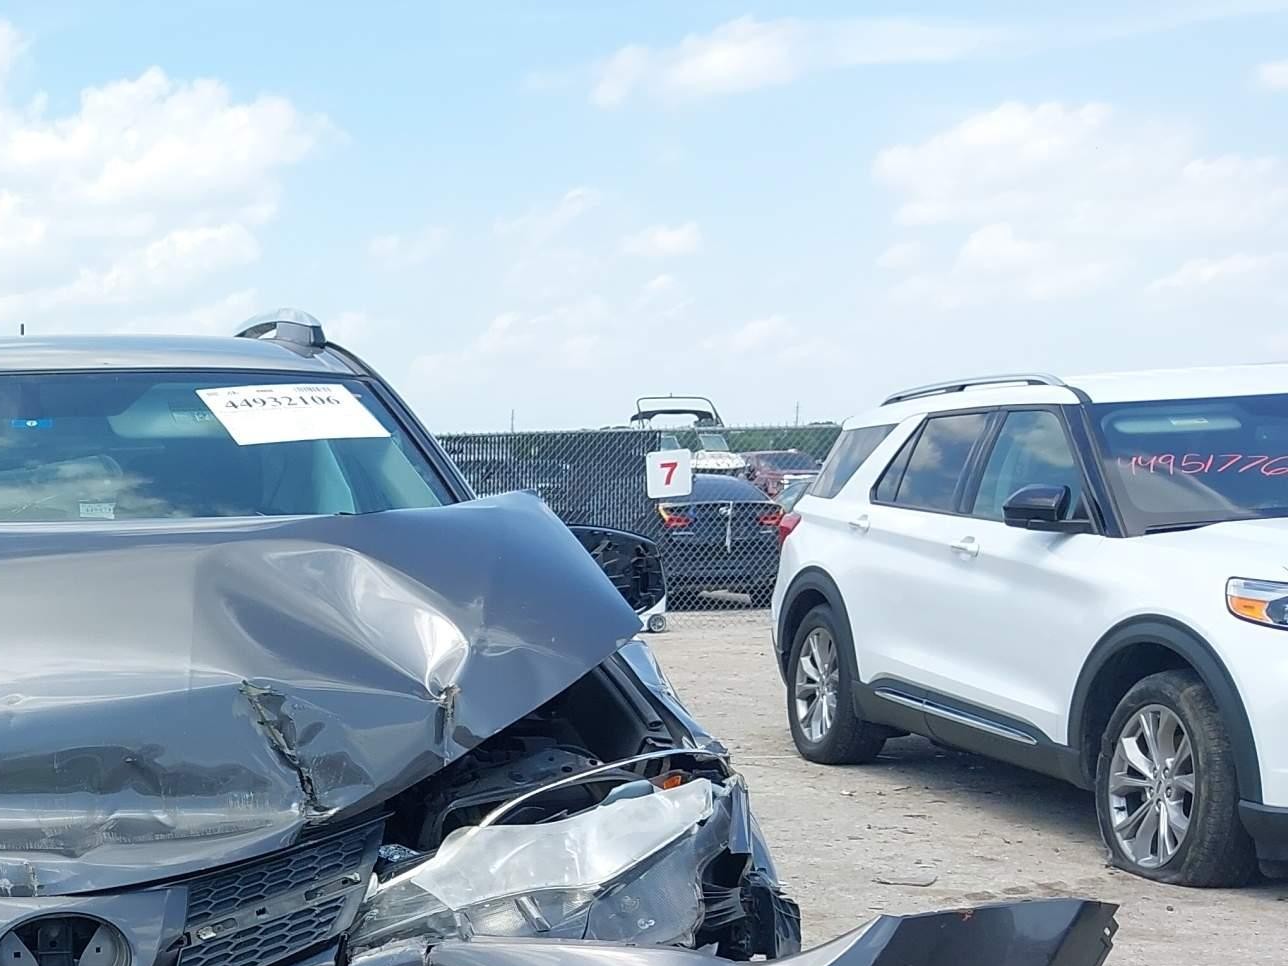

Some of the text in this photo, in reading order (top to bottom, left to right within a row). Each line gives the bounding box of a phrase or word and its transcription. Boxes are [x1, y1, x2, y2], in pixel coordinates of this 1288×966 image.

[224, 394, 341, 410] 44932106
[659, 461, 678, 486] 7
[1117, 453, 1288, 476] 44951776
